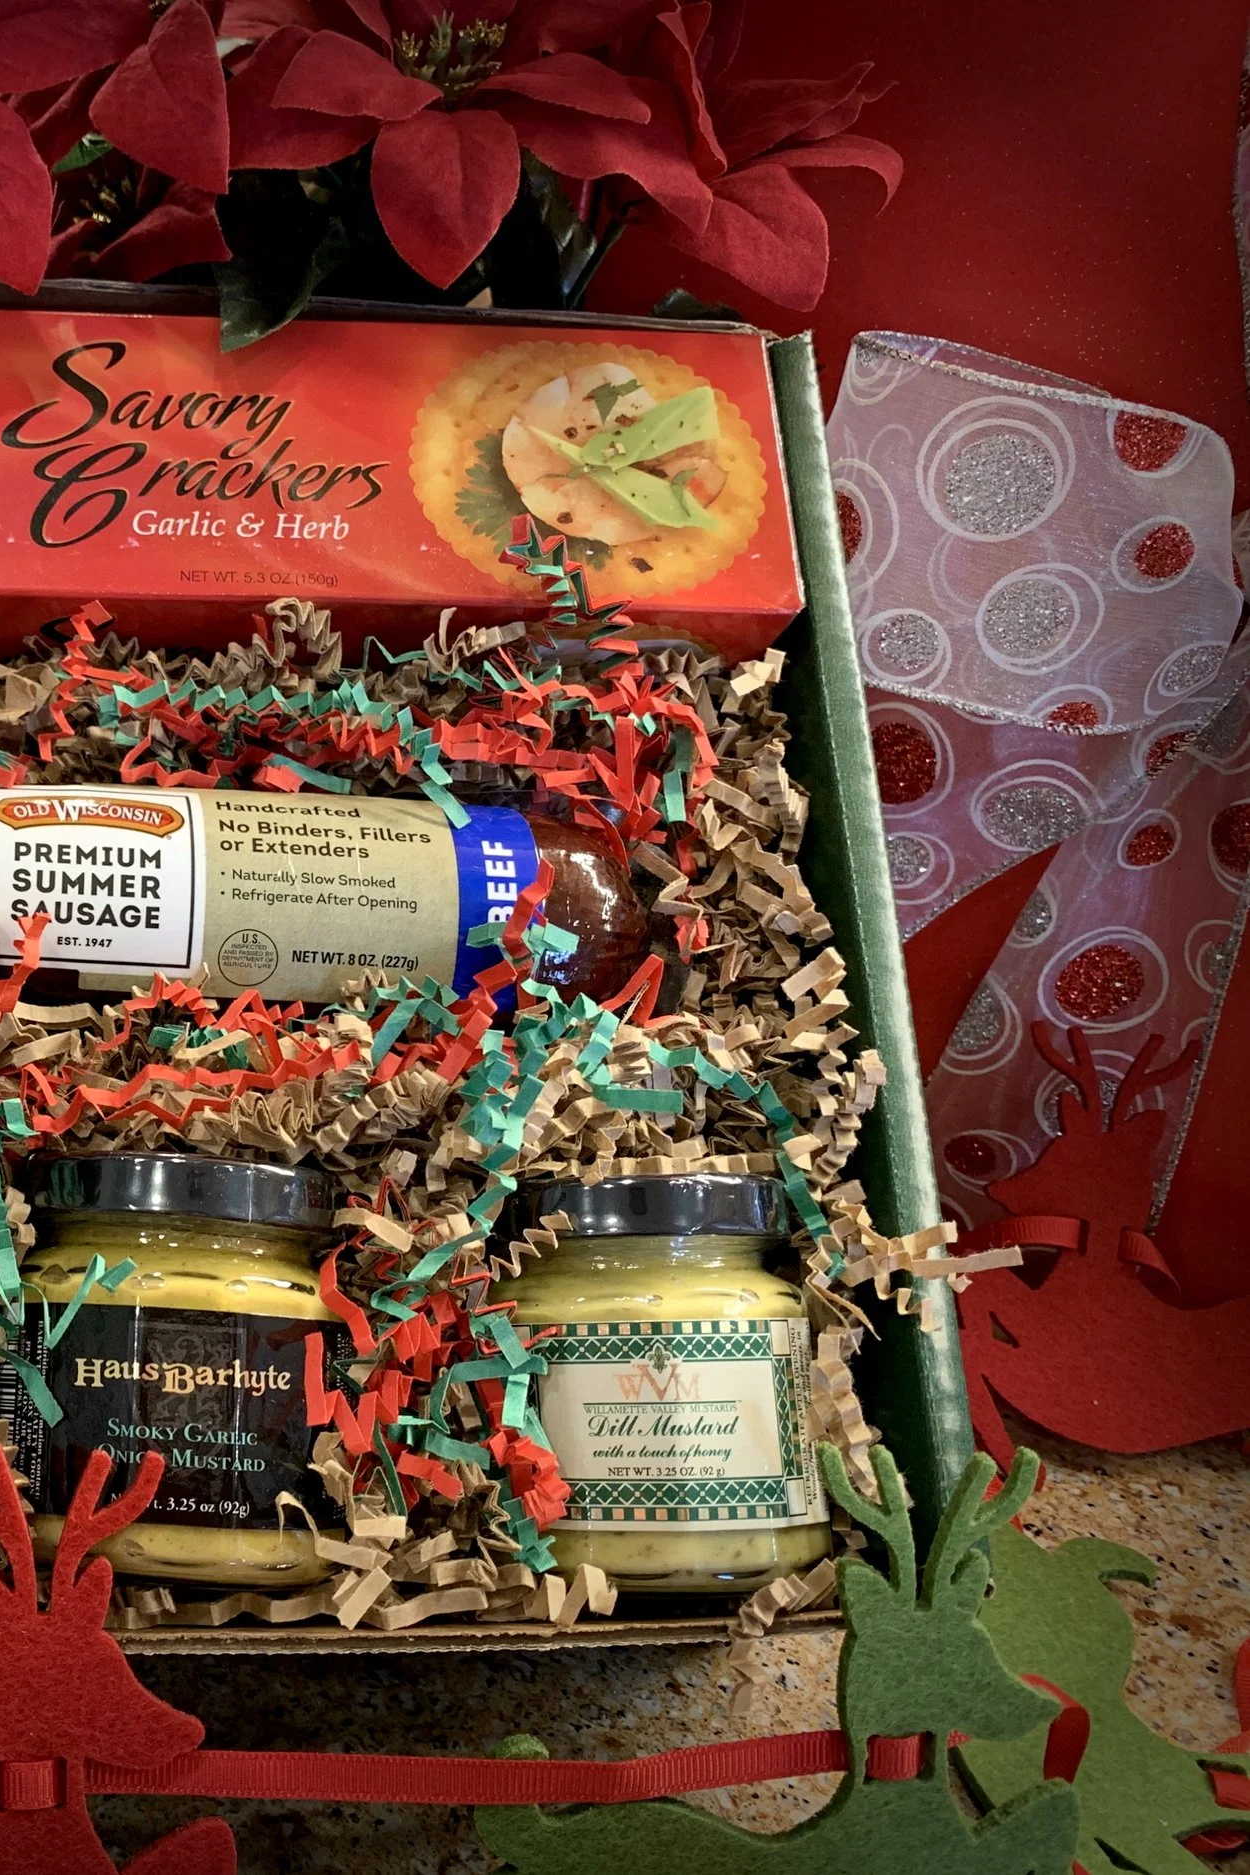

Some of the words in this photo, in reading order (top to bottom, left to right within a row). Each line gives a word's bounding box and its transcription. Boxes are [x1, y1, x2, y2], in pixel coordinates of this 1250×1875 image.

[1, 341, 295, 461] Savory
[30, 438, 390, 549] Crackers
[132, 510, 225, 537] Garlic
[236, 512, 265, 538] &
[275, 513, 349, 541] Herb
[180, 570, 209, 583] NET
[213, 570, 239, 584] WT.
[243, 571, 265, 584] 5.3
[13, 803, 50, 818] OLD
[53, 799, 164, 826] WISCONSIN
[216, 801, 361, 818] Handcrafted
[219, 820, 250, 834] No
[258, 822, 353, 841] Binders,
[361, 827, 431, 843] Fillers
[14, 841, 162, 869] PREMIUM
[220, 840, 244, 852] or
[252, 838, 370, 858] Extenders
[12, 868, 160, 900] SUMMER
[232, 868, 297, 886] Naturally
[301, 872, 335, 885] Slow
[339, 874, 396, 889] Smoked
[232, 888, 314, 905] Refrigerate
[316, 892, 354, 906] After
[357, 895, 418, 913] Opening
[10, 898, 160, 929] SAUSAGE
[56, 936, 81, 946] EST.
[85, 937, 113, 948] 1947
[241, 933, 260, 944] U.S.
[292, 950, 318, 963] NET
[321, 951, 345, 965] WT.
[348, 954, 356, 966] 8
[358, 954, 378, 967] OZ.
[381, 955, 419, 971] (227g)
[789, 1326, 800, 1379] OPENING
[583, 1405, 648, 1414] WILLAMETTE
[650, 1405, 686, 1413] VALLEY
[689, 1404, 738, 1412] MUSTARDS
[795, 1381, 805, 1421] AFTER
[107, 1417, 177, 1441] SMOKY
[184, 1423, 258, 1446] GARLIC
[587, 1415, 639, 1437] Dill
[638, 1415, 739, 1437] Mustard
[172, 1449, 266, 1472] MUSTARD
[593, 1444, 624, 1458] with
[626, 1449, 636, 1458] a
[638, 1444, 677, 1458] touch
[679, 1444, 695, 1463] of
[692, 1444, 732, 1462] honey
[608, 1467, 631, 1477] NET
[633, 1467, 654, 1477] WT.
[656, 1467, 676, 1477] 3.25
[680, 1467, 697, 1477] OZ.
[166, 1497, 196, 1511] 3.25
[200, 1502, 215, 1513] oz
[219, 1500, 251, 1518] (92g)
